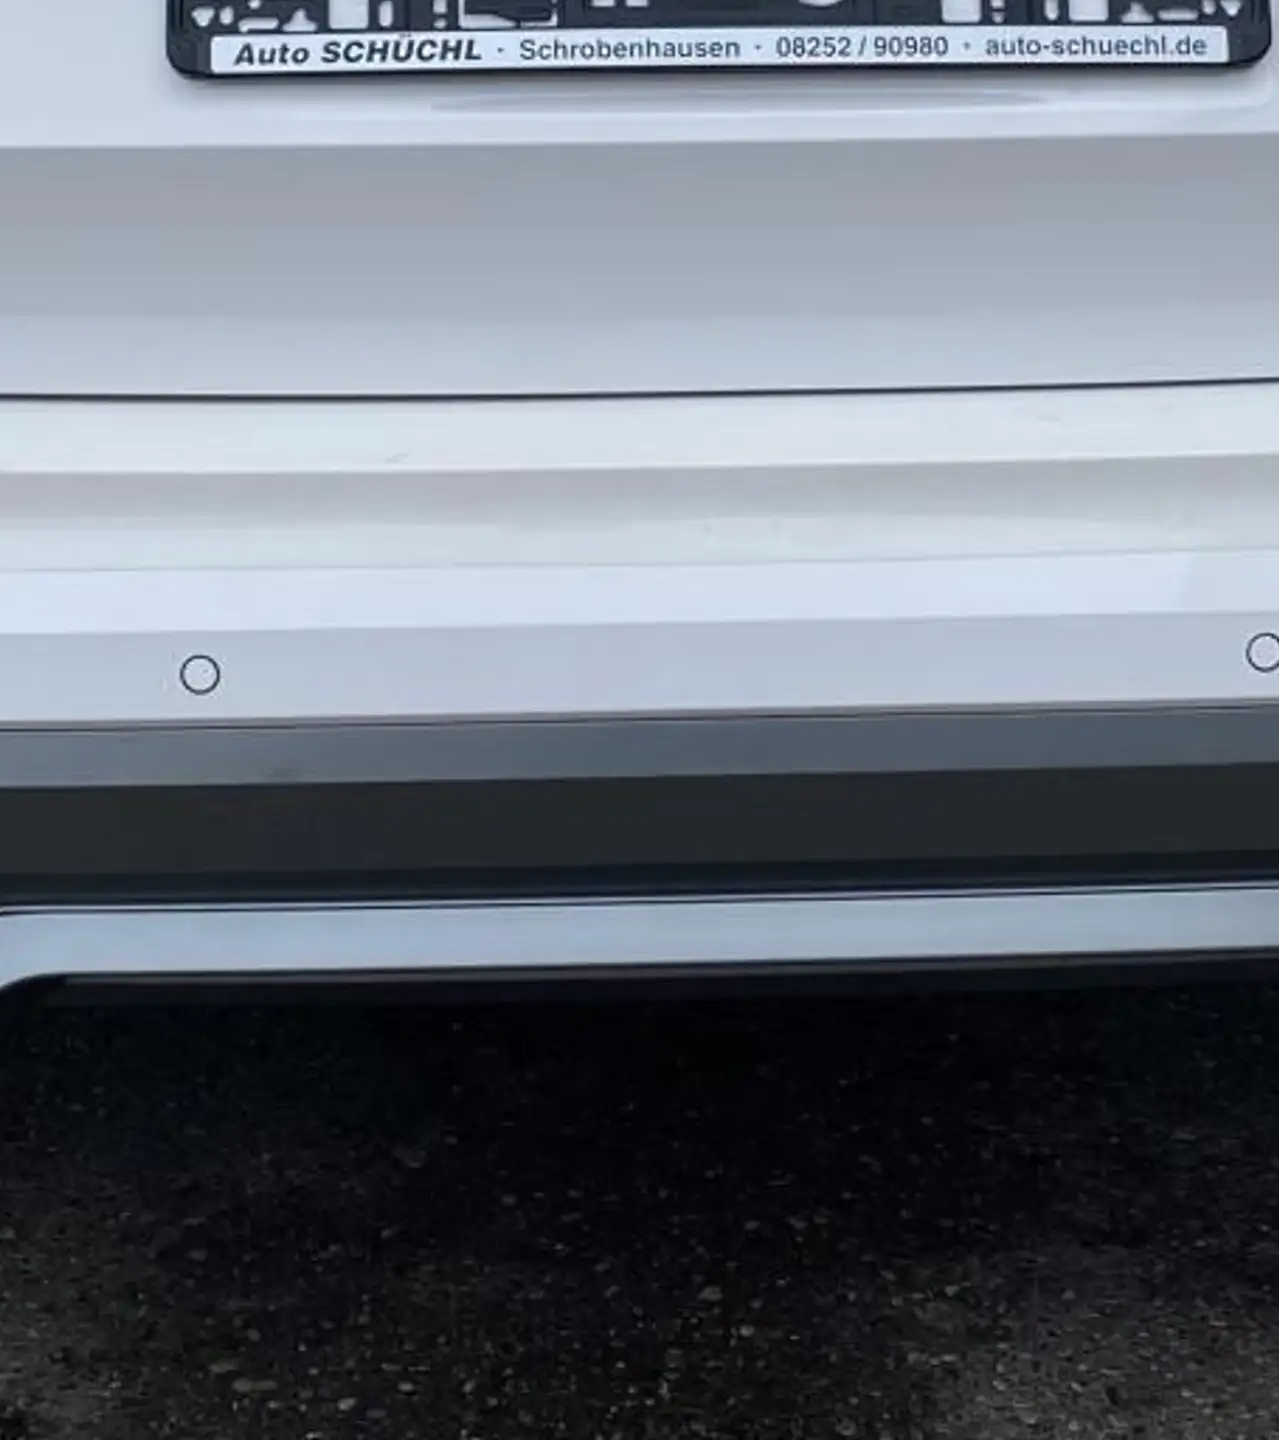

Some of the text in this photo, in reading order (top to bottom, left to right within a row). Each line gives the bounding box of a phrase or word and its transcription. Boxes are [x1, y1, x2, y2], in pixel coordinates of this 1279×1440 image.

[233, 42, 311, 66] Auto
[321, 34, 483, 64] SCHÜCHL
[519, 37, 741, 61] Schrobenhausen
[985, 33, 1208, 57] auto-schuechl.de
